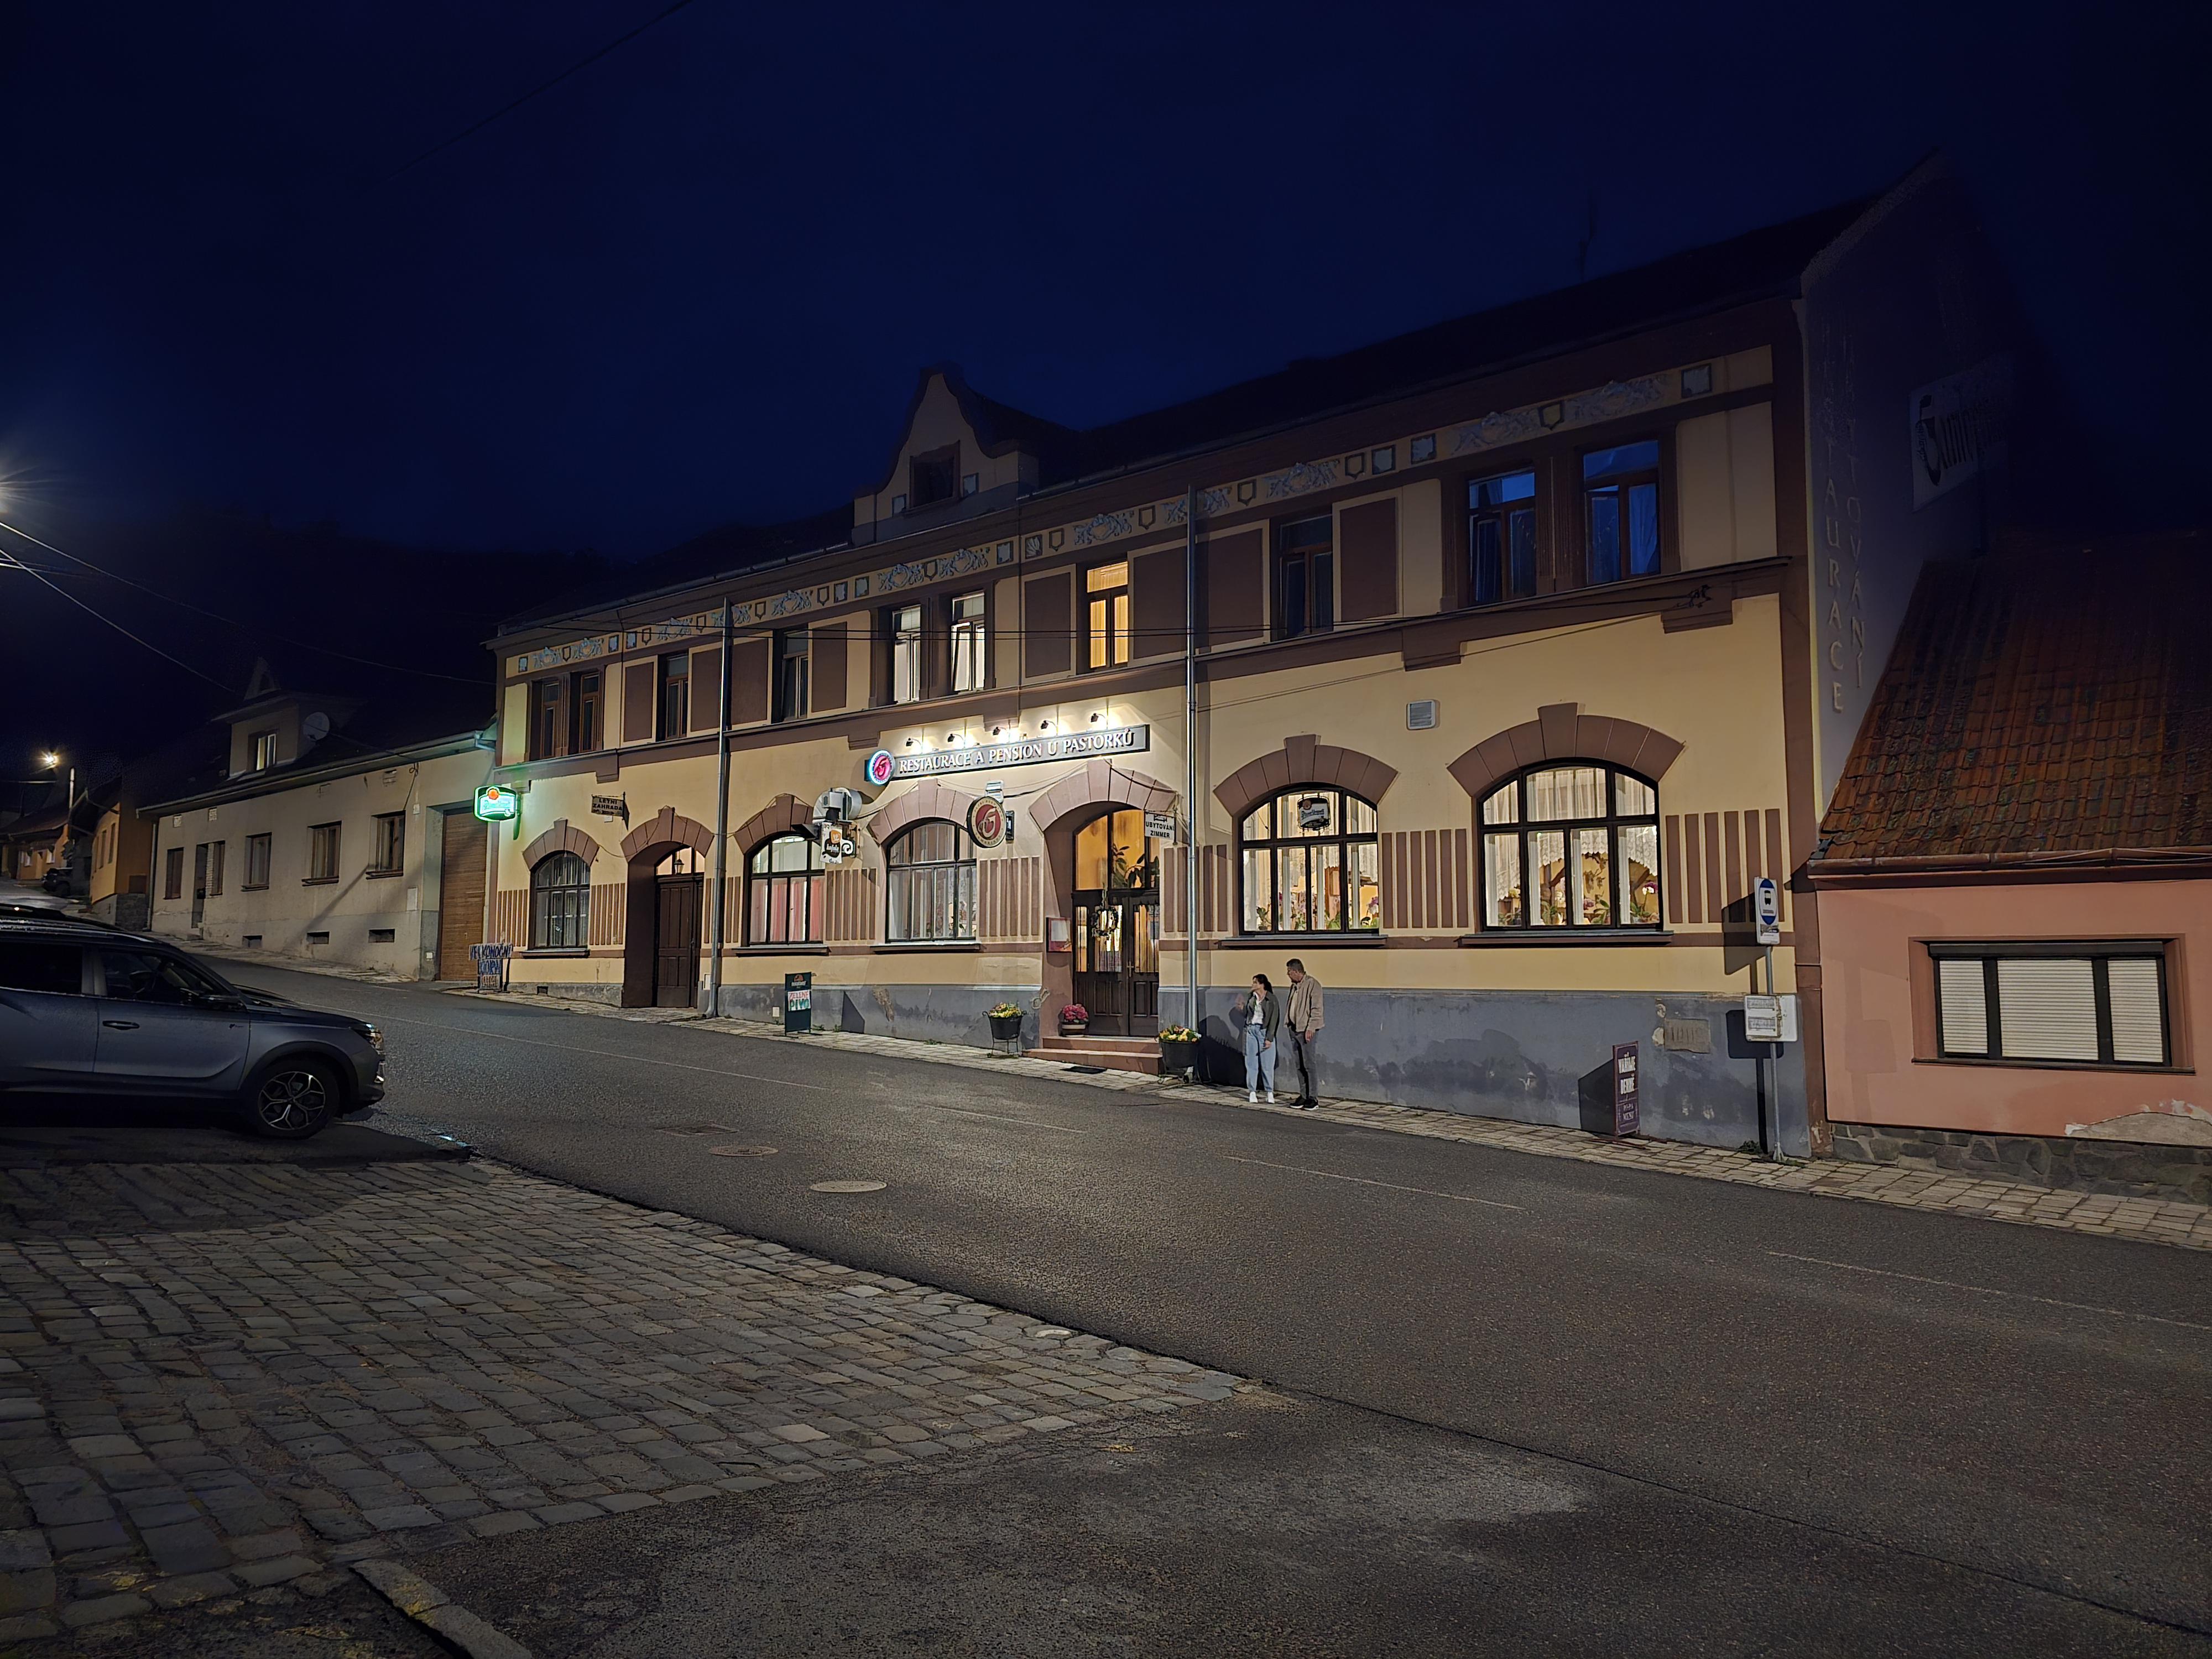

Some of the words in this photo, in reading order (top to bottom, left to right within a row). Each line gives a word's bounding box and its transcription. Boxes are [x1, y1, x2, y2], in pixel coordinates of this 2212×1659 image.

[899, 752, 972, 774] RESTAURACE
[975, 752, 984, 764] A
[989, 743, 1042, 764] PENSION
[1047, 742, 1058, 756] U
[1063, 728, 1134, 753] PASTORKŮ
[790, 998, 810, 1010] PIVO
